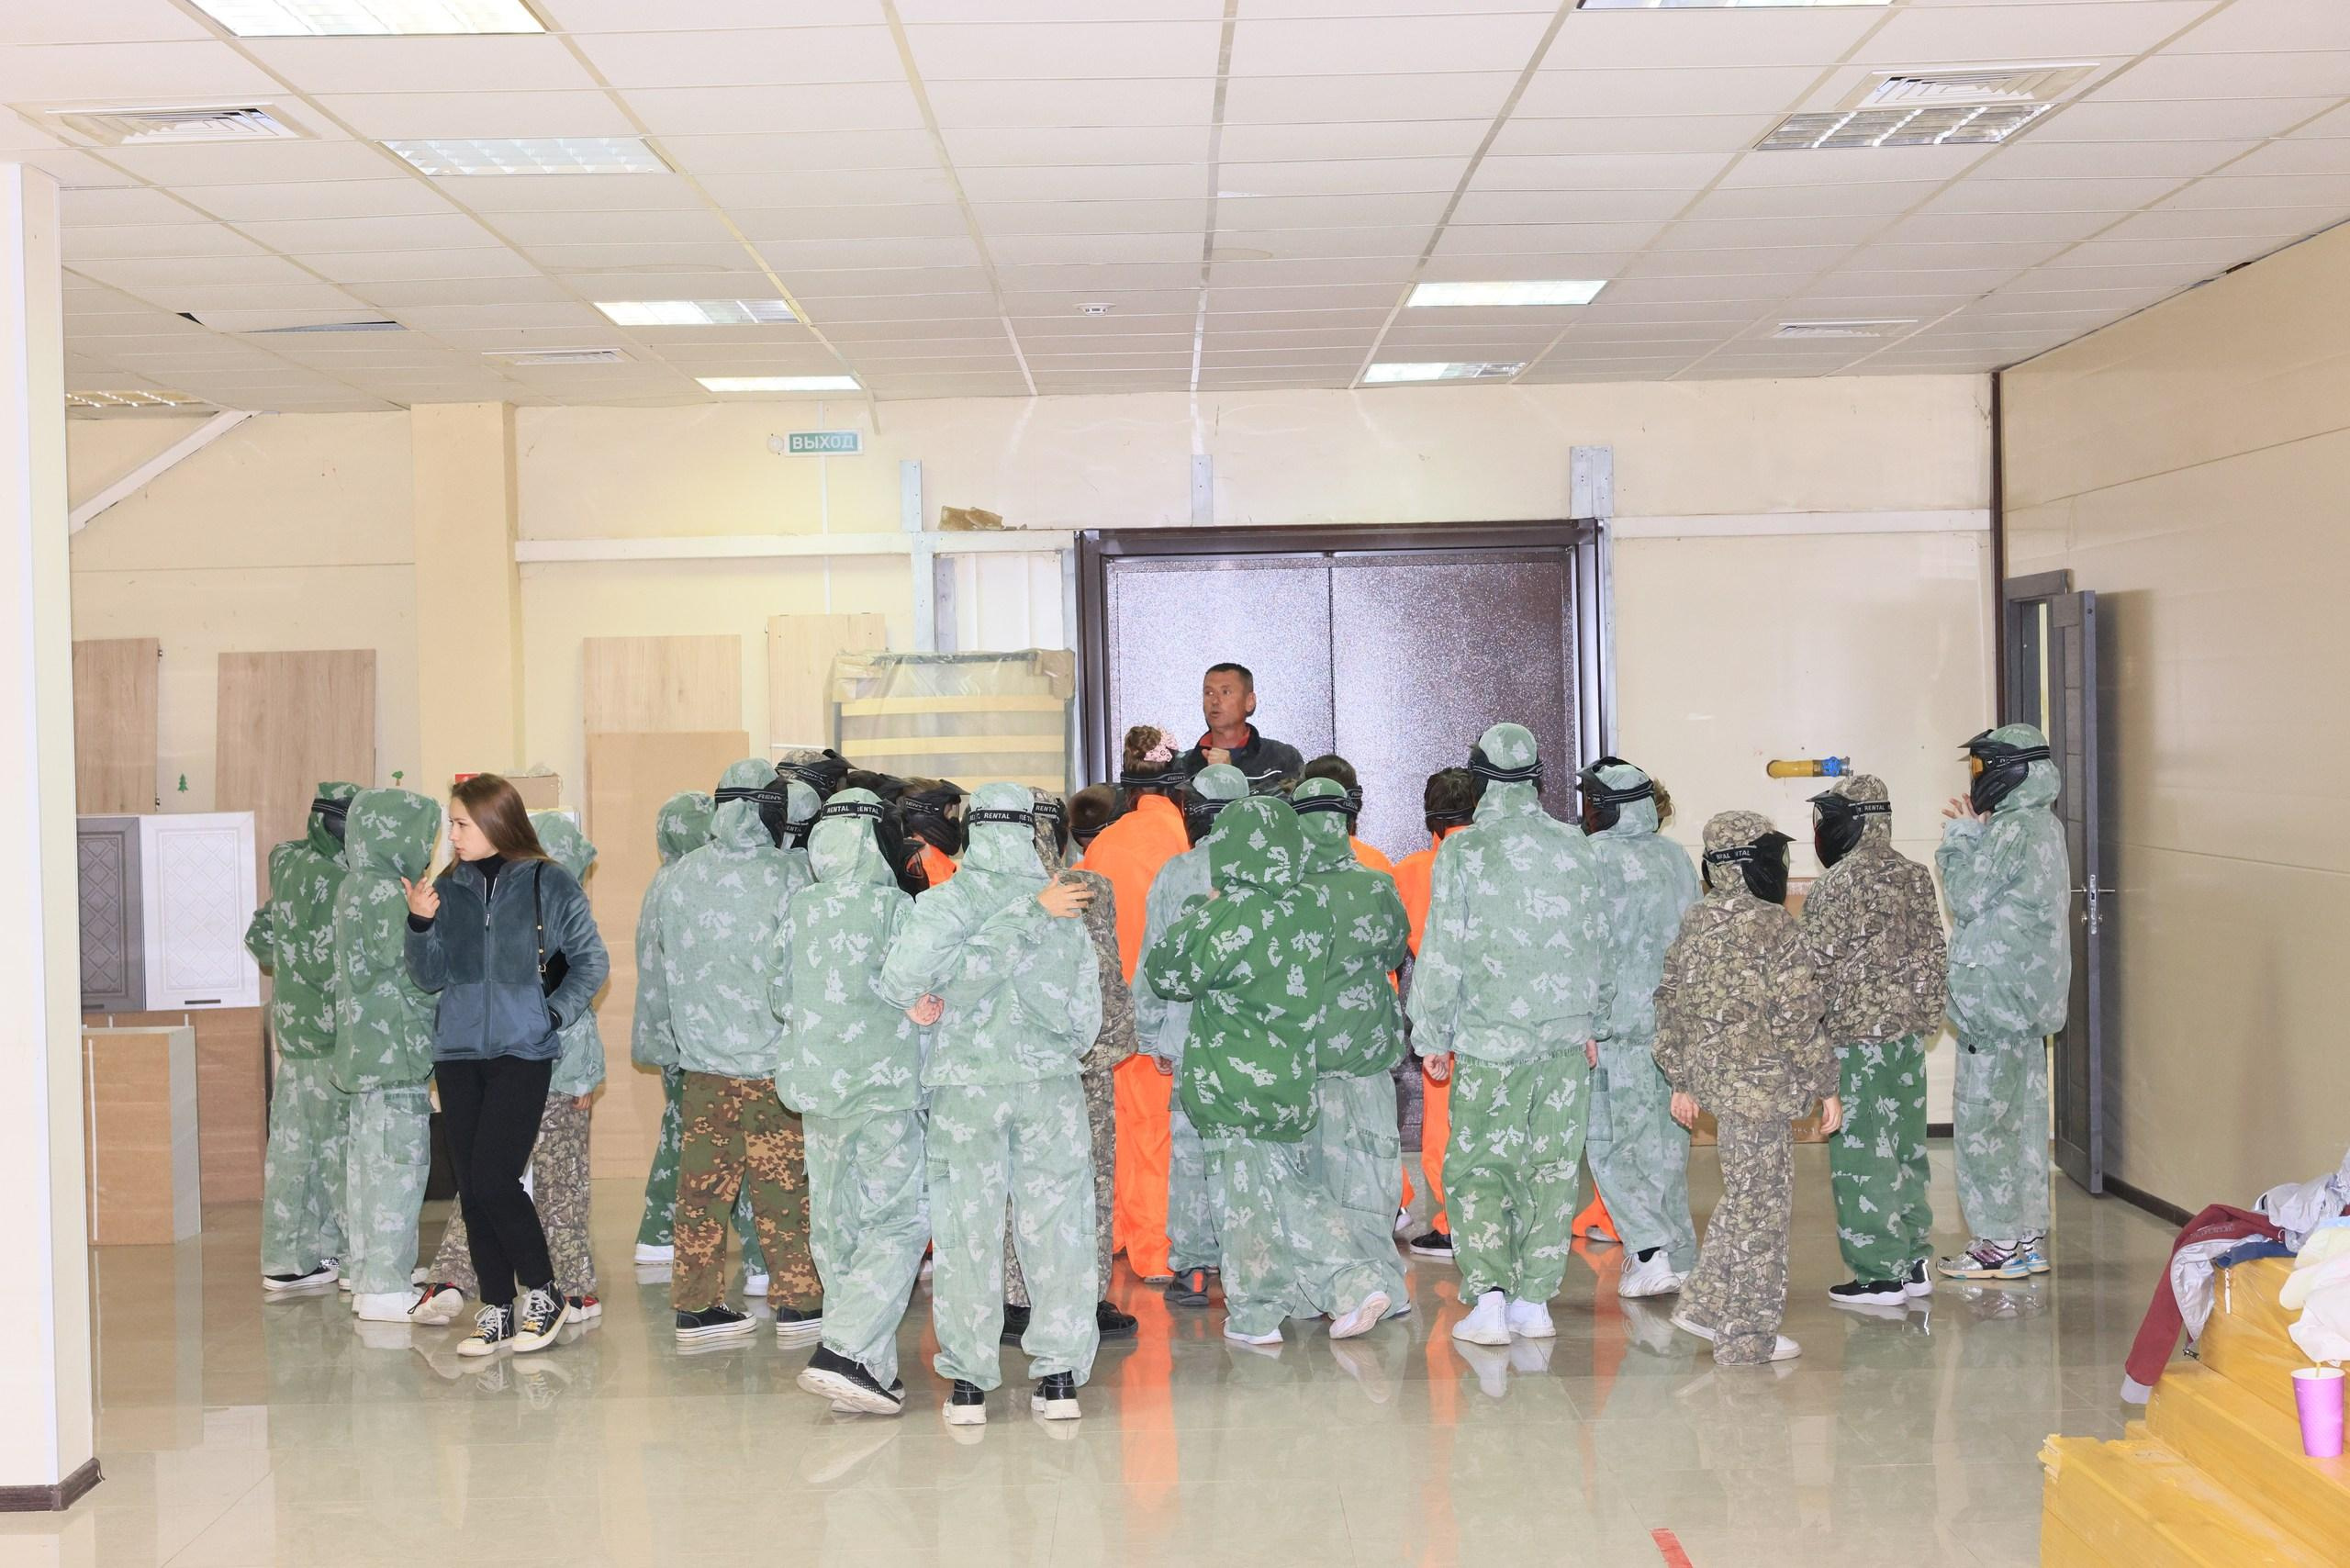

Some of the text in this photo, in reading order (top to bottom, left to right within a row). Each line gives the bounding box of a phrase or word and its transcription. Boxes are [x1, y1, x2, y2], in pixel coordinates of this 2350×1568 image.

[792, 435, 855, 450] ВЫХОД
[826, 805, 850, 813] RENTAL
[1035, 804, 1058, 813] RENTA
